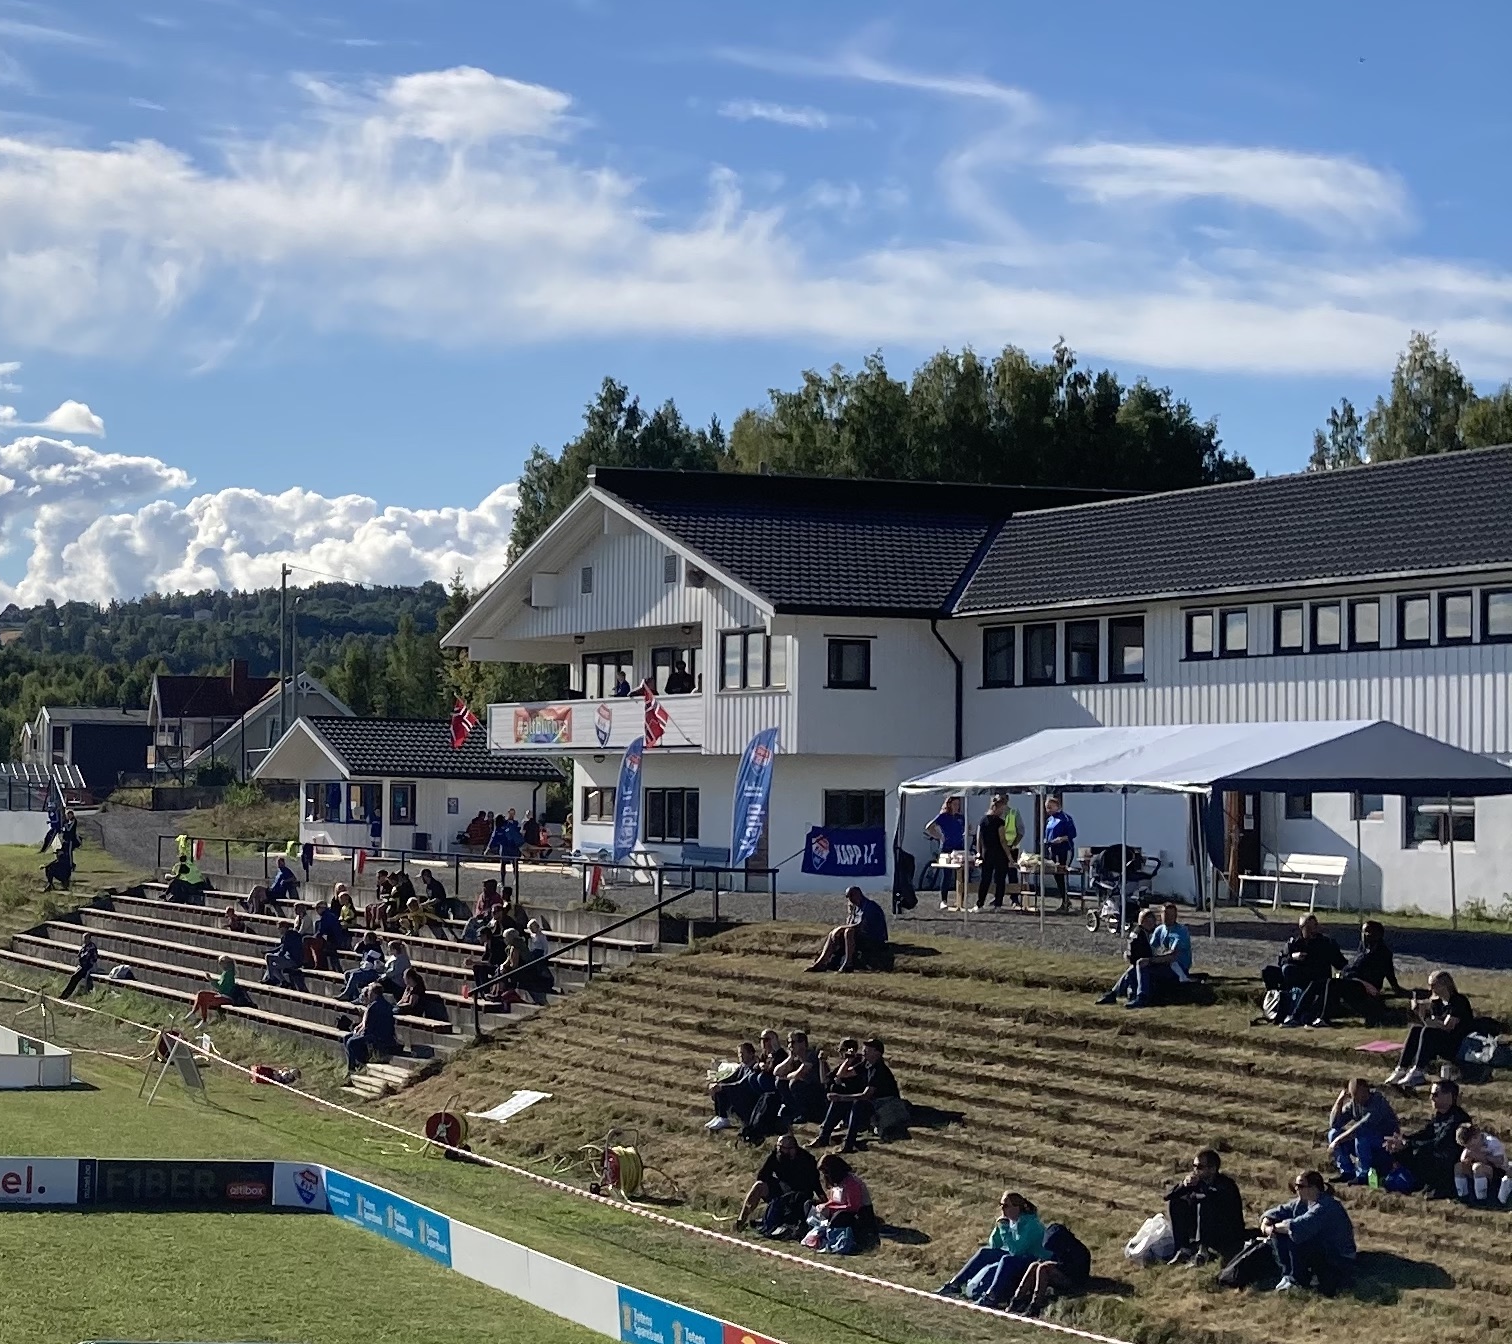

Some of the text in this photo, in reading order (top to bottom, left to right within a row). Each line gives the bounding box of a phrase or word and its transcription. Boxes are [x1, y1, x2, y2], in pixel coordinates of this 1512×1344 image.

[616, 806, 638, 849] Kapp
[739, 803, 766, 855] Kapp
[833, 844, 862, 866] KAPP
[229, 1185, 263, 1197] altibox
[632, 1307, 653, 1327] Totens
[633, 1322, 664, 1344] Sparebank
